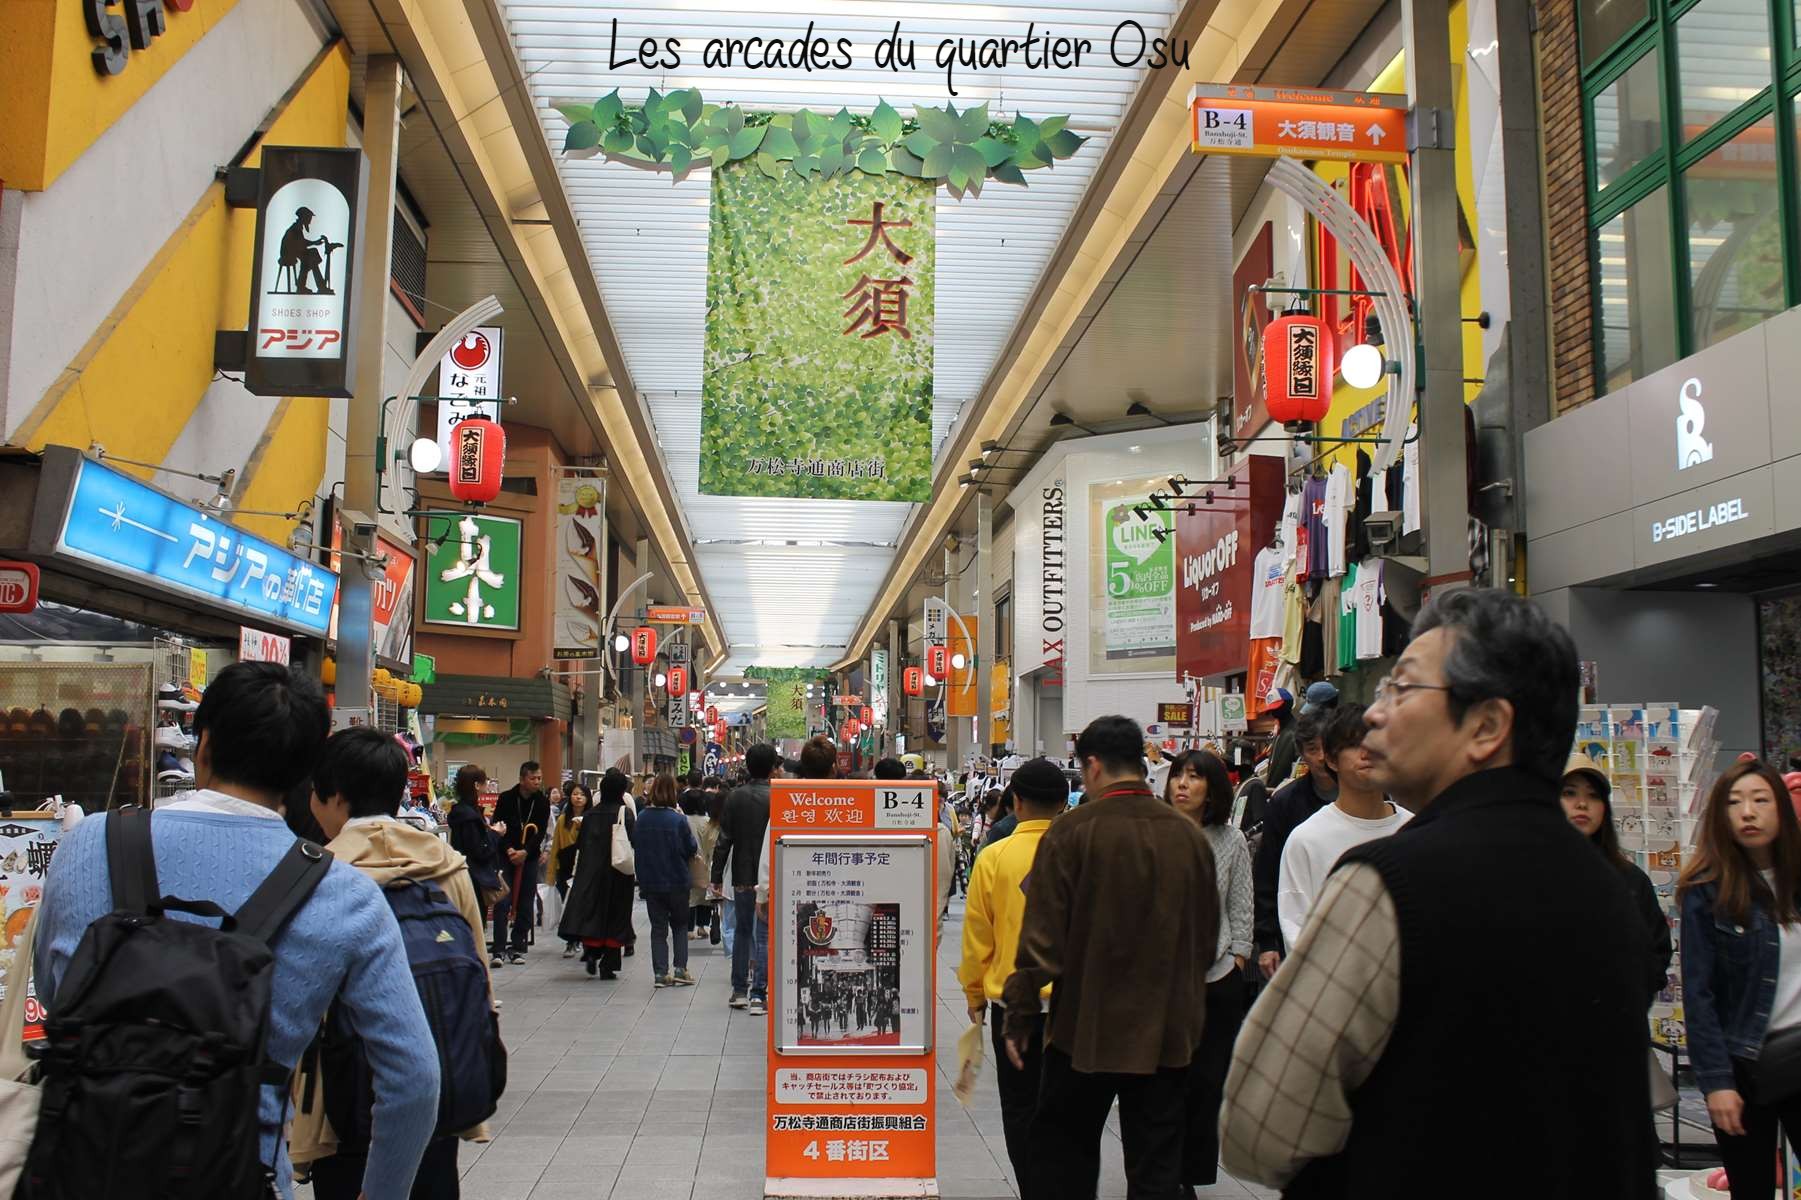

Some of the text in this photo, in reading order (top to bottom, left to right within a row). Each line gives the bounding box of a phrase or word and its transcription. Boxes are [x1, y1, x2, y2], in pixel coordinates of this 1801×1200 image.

[1203, 110, 1248, 130] B-4
[1277, 119, 1356, 143] 大須観音
[843, 201, 914, 341] 大須
[271, 307, 331, 318] SHOES SHOP
[259, 328, 341, 351] アジア
[748, 457, 887, 478] 万松寺通商店街
[1652, 497, 1750, 543] B-SIDE LABEL
[1121, 524, 1158, 543] LINE
[1042, 488, 1064, 632] OUTFITTERS
[1109, 561, 1131, 596] 5
[791, 684, 804, 711] 大須
[1163, 711, 1188, 721] SALE
[788, 792, 856, 806] Welcome
[882, 791, 924, 810] B-4
[781, 808, 816, 824] 환영
[823, 808, 863, 824] 欢迎
[811, 852, 891, 866] 年間行事予定
[790, 1072, 910, 1081] 当、商店街ではチラシ配布および
[808, 1091, 893, 1101] で禁止されております。
[774, 1115, 927, 1131] 万松寺通商店街振興組合
